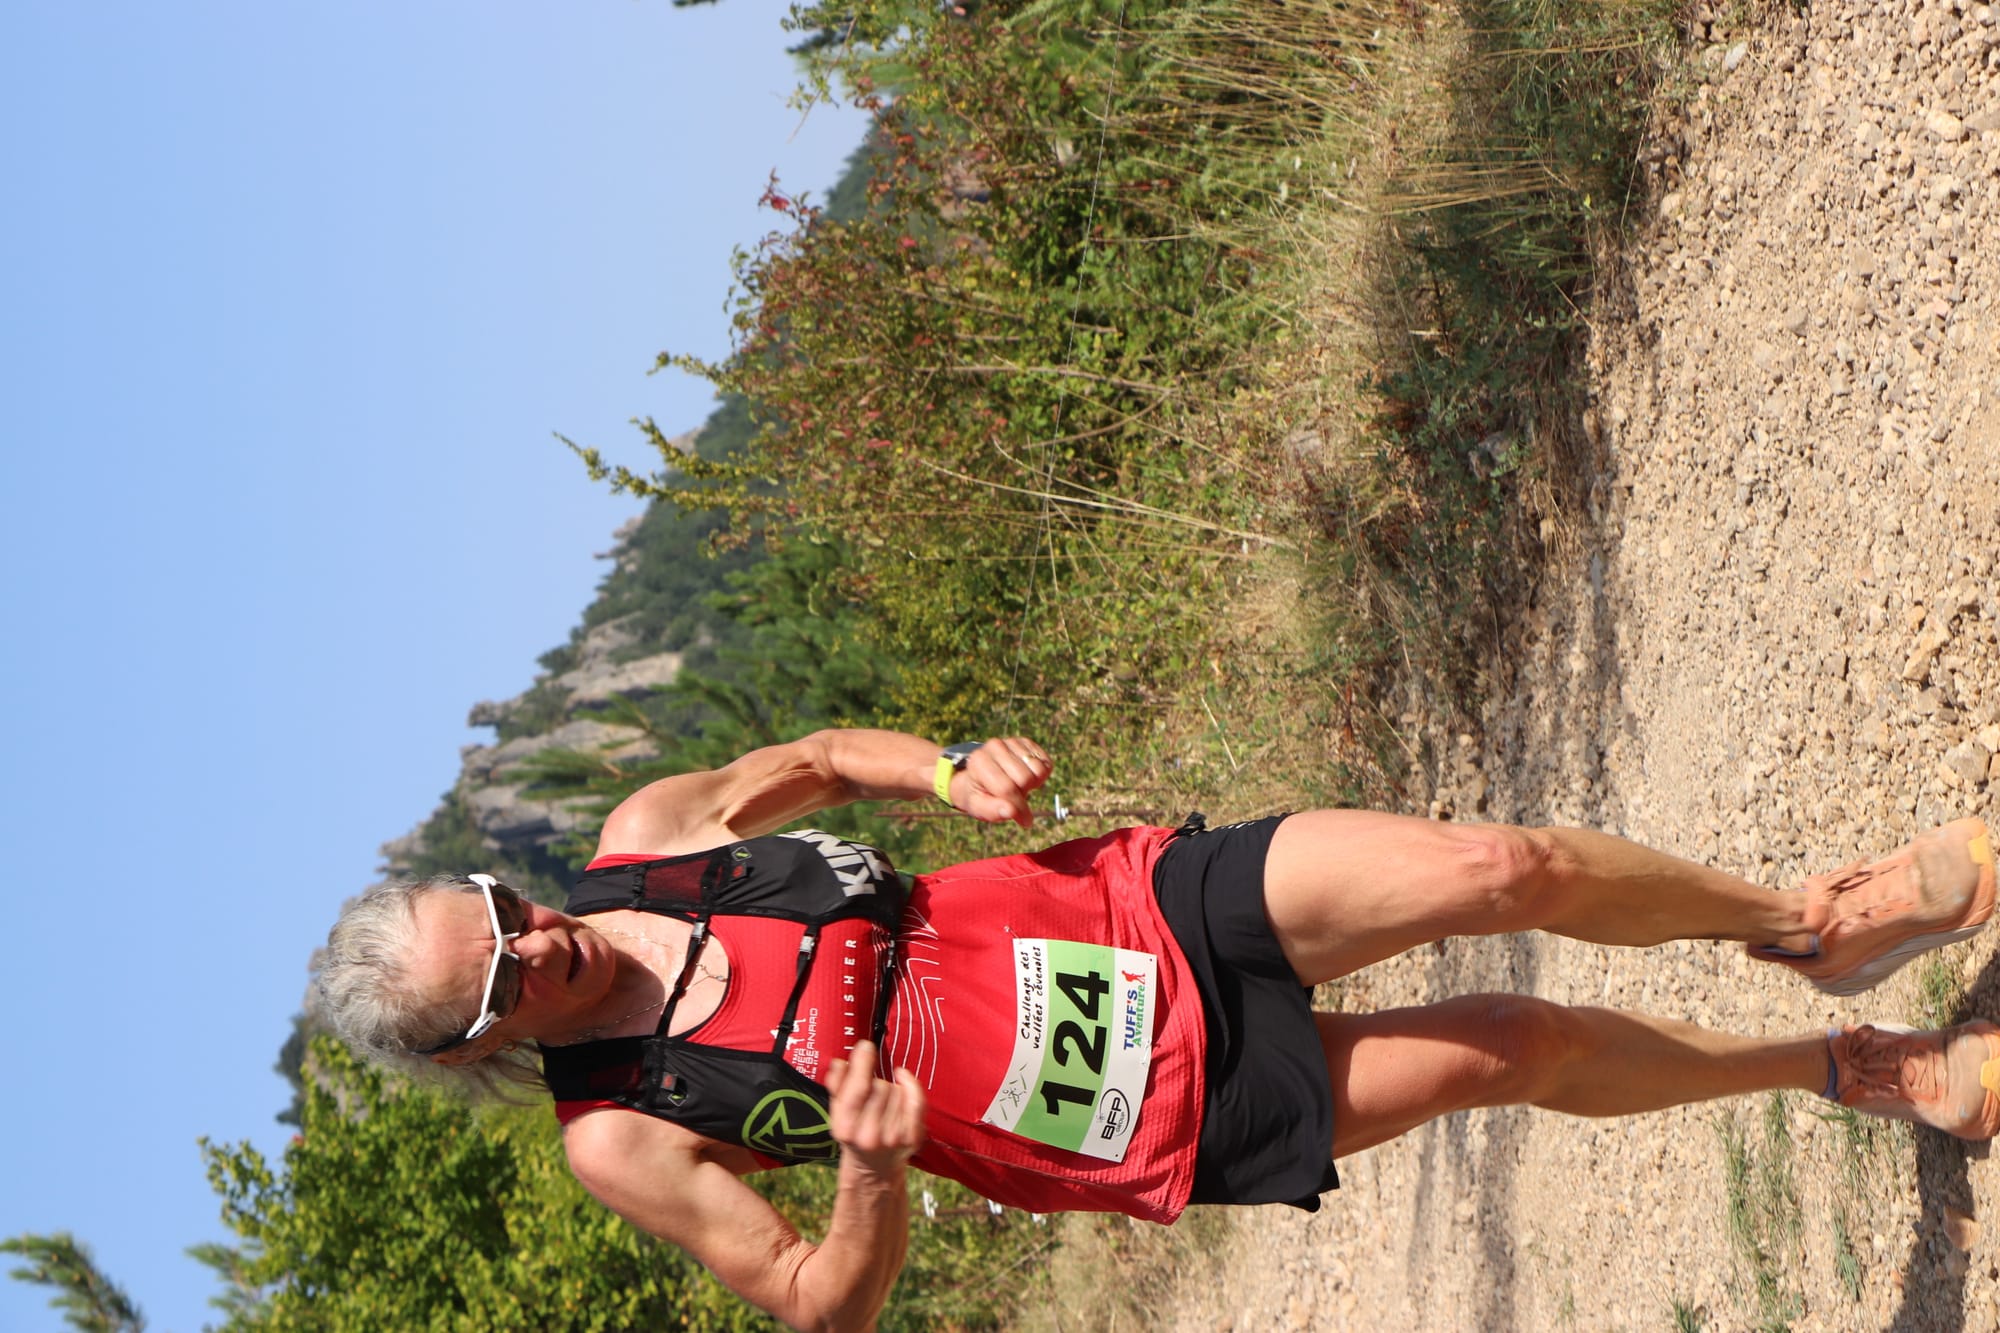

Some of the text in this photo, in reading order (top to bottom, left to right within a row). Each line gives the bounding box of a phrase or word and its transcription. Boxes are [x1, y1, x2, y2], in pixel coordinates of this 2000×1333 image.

[843, 939, 857, 1050] INISHER
[1020, 951, 1034, 1040] Challenge des
[1032, 946, 1043, 1049] vallées cévenoles
[1124, 989, 1138, 1050] TUFF'S
[1132, 985, 1146, 1047] Aventure
[795, 1048, 806, 1074] BIER
[1040, 970, 1110, 1116] 124
[1101, 1096, 1122, 1140] BFP
[1115, 1111, 1126, 1133] GROUP
